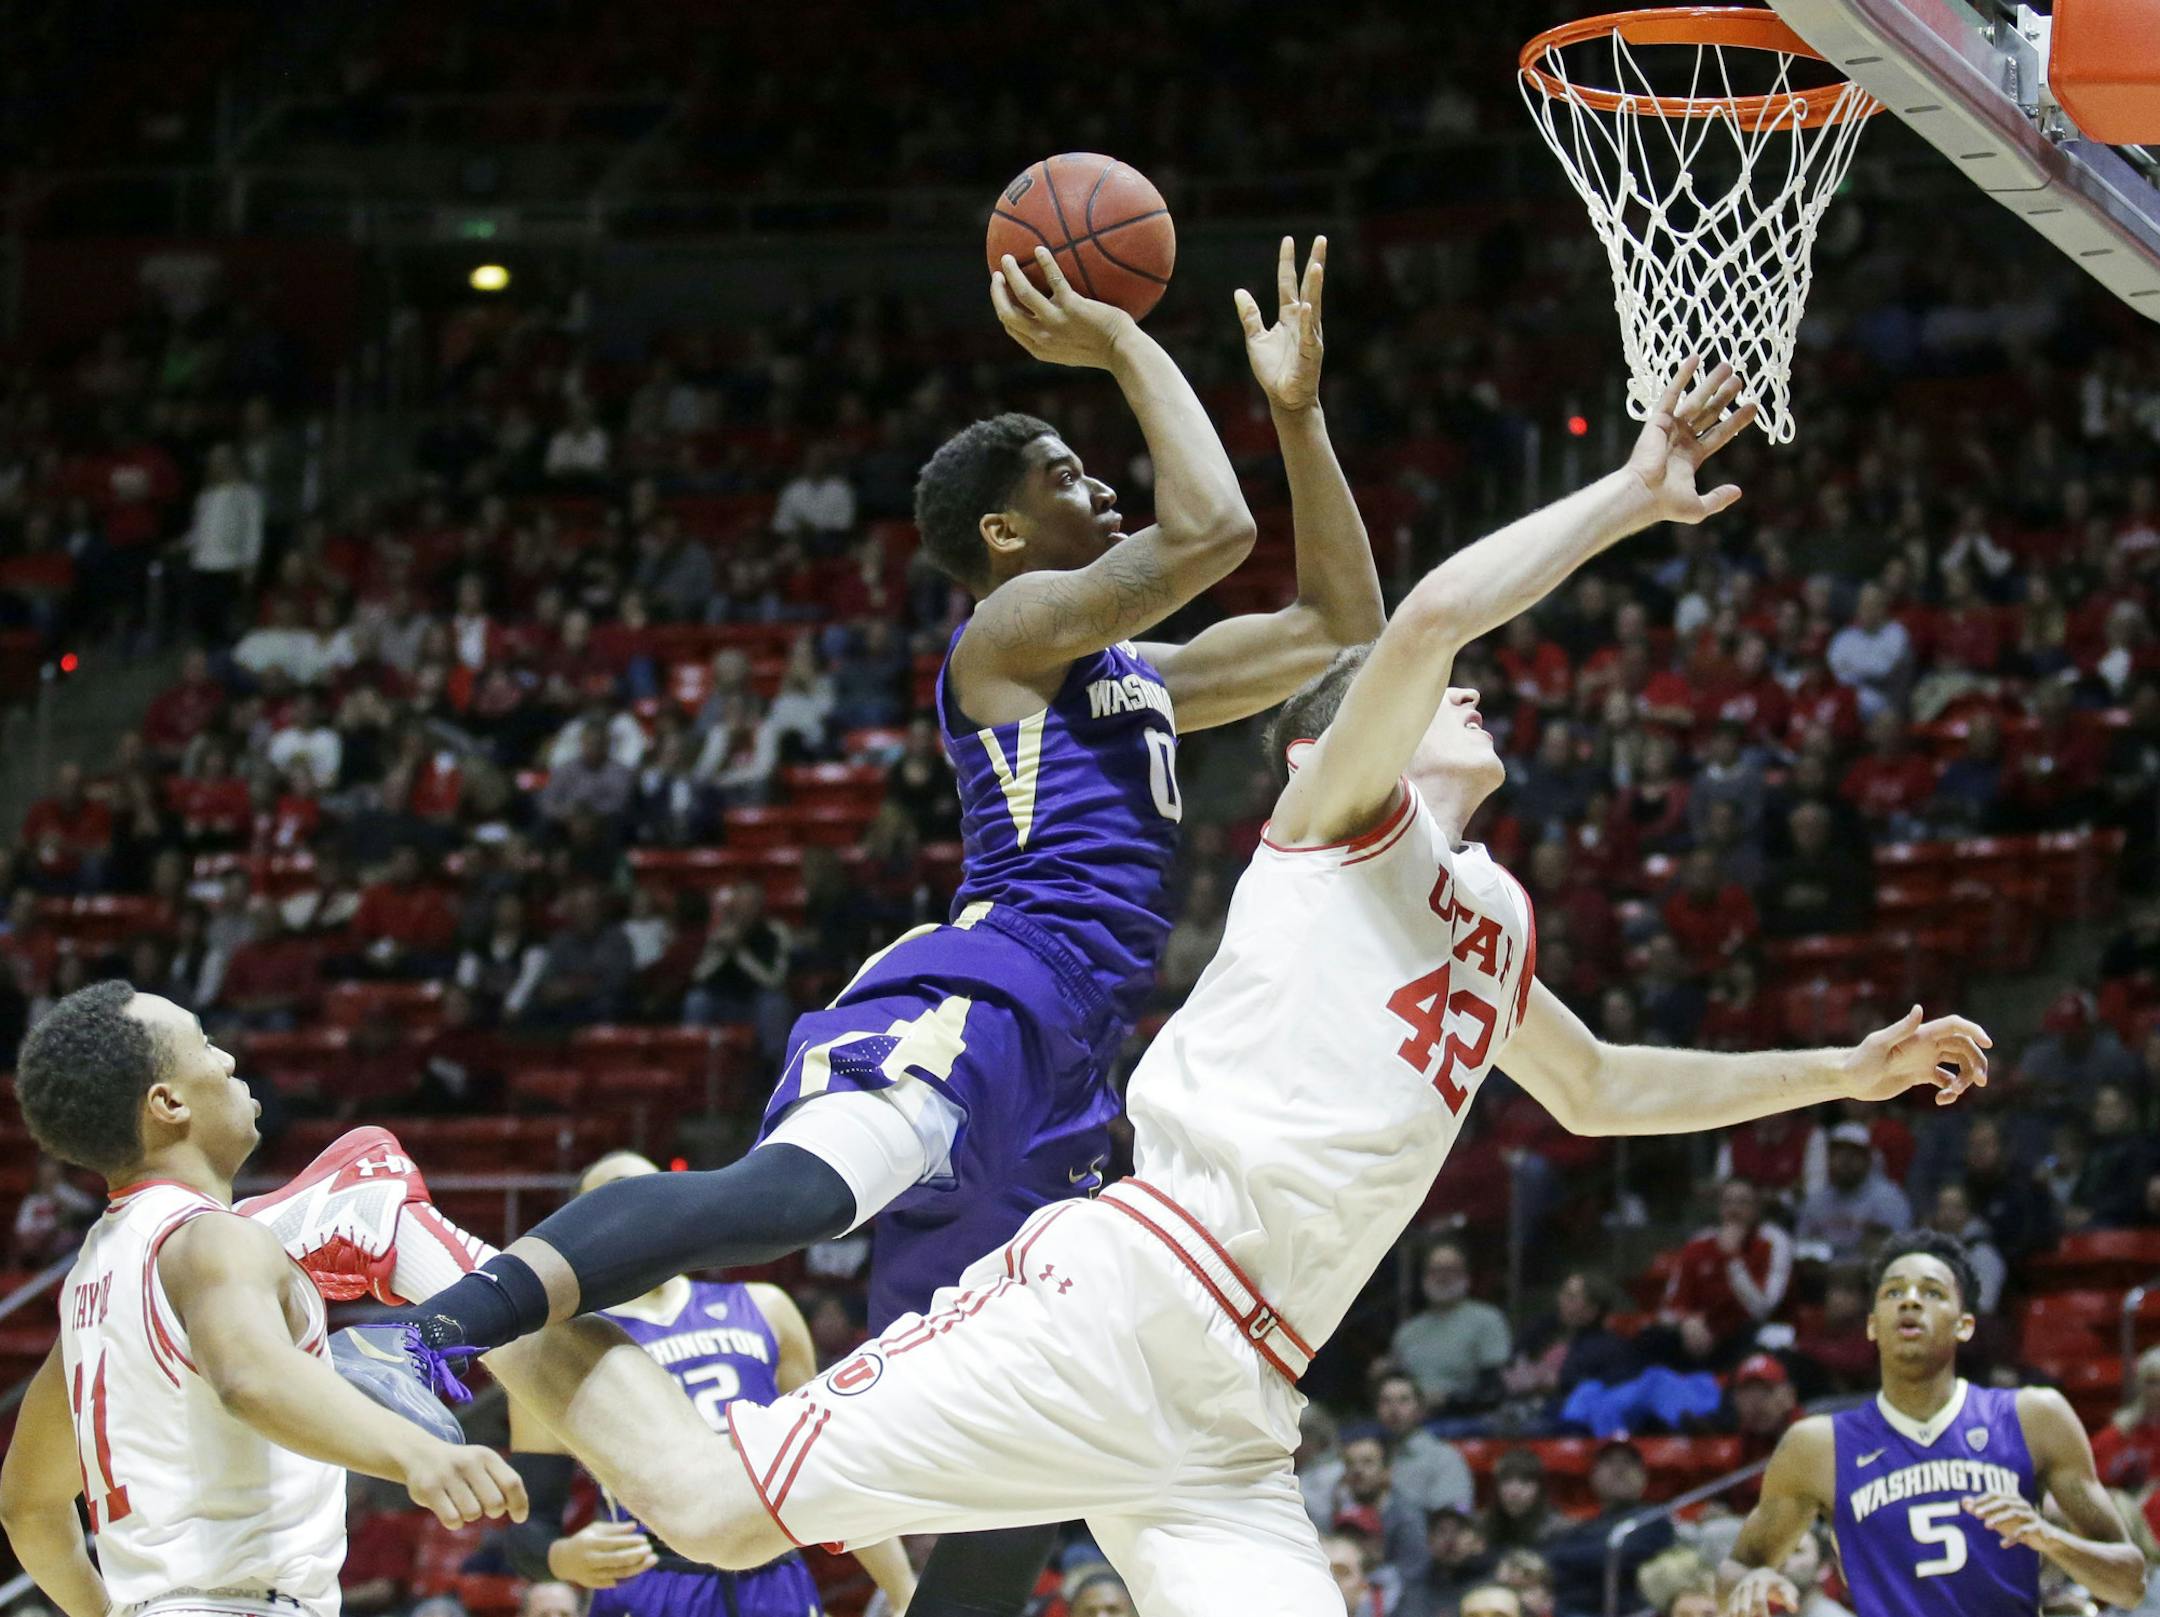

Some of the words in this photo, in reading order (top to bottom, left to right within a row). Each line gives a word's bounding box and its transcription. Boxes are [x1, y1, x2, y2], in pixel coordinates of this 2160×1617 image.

[1143, 726, 1183, 824] 0
[1386, 961, 1498, 1118] 42
[1249, 1306, 1278, 1339] U
[672, 1362, 741, 1434] 2
[833, 1357, 876, 1389] U
[73, 1347, 132, 1536] 11
[1850, 1458, 2020, 1524] WASHINGTON
[1908, 1501, 1968, 1579] 5
